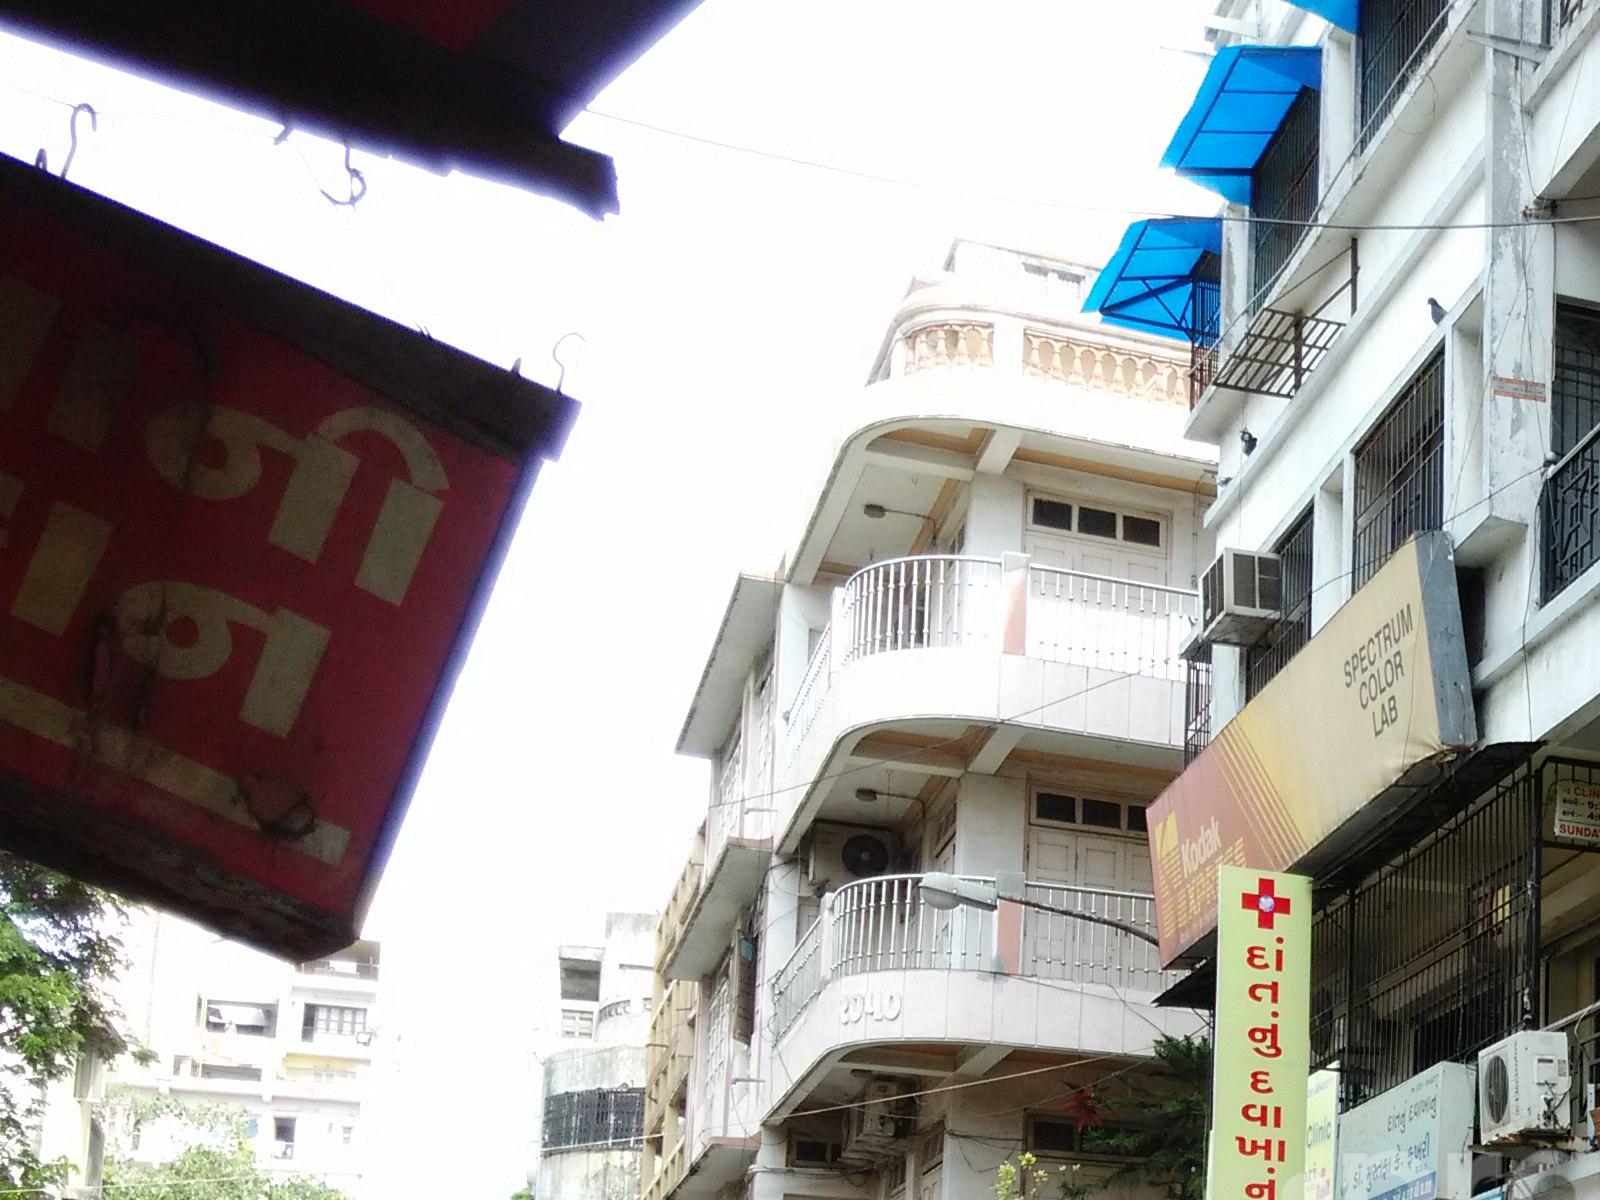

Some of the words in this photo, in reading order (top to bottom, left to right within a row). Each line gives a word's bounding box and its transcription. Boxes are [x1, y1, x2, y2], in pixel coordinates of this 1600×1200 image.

[1344, 604, 1413, 688] SPECTRUM
[1359, 651, 1405, 710] COLOR
[1372, 695, 1399, 738] LAB
[1180, 815, 1222, 879] Kodak
